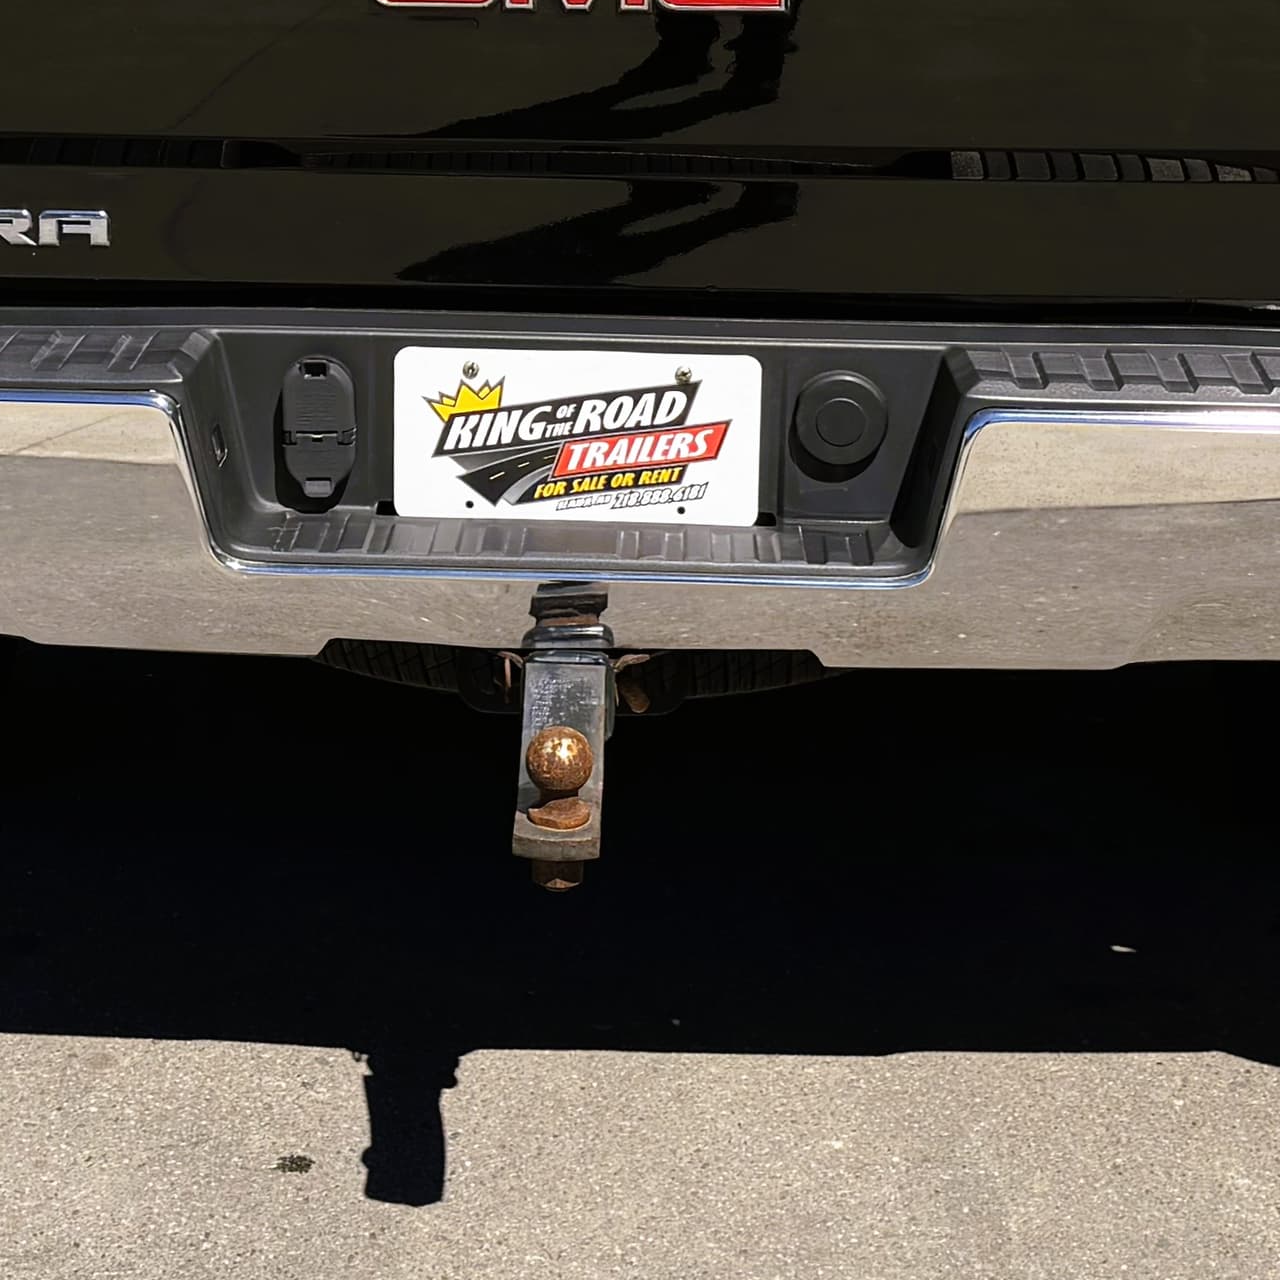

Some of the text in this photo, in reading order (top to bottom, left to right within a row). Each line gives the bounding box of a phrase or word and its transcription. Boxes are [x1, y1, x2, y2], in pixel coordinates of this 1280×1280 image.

[443, 391, 687, 450] KING OF THE ROAD
[567, 429, 714, 470] TRAILERS
[534, 467, 683, 499] FOR SALE OR RENT
